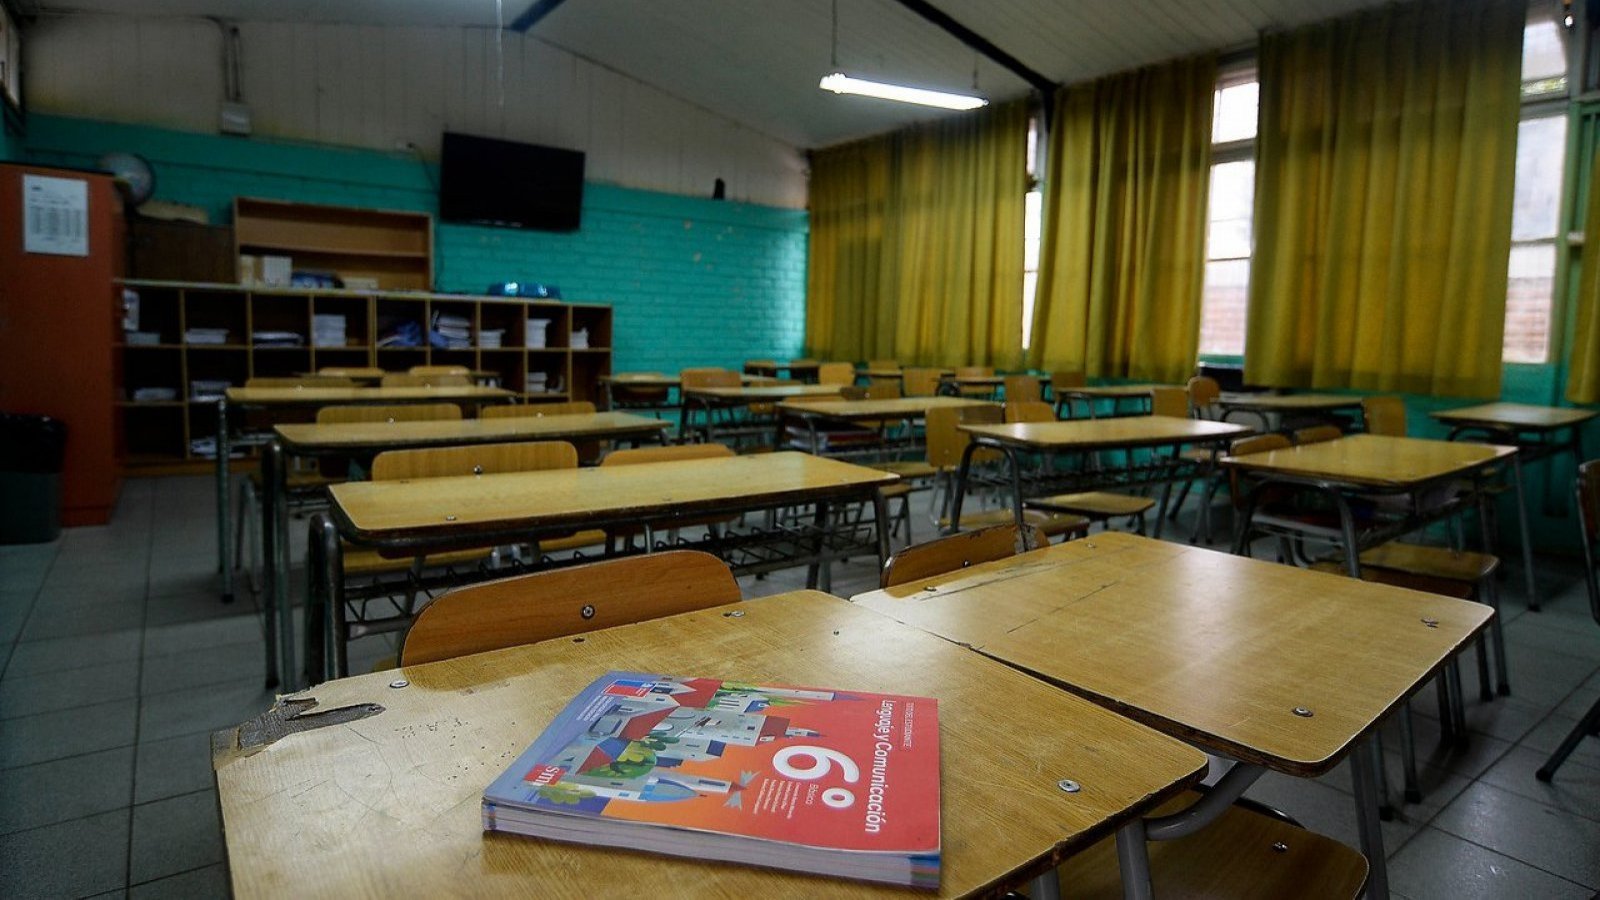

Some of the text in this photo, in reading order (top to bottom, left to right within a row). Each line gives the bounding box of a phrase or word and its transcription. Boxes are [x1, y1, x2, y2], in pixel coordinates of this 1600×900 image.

[865, 700, 897, 832] Lenguaje y Comunicación
